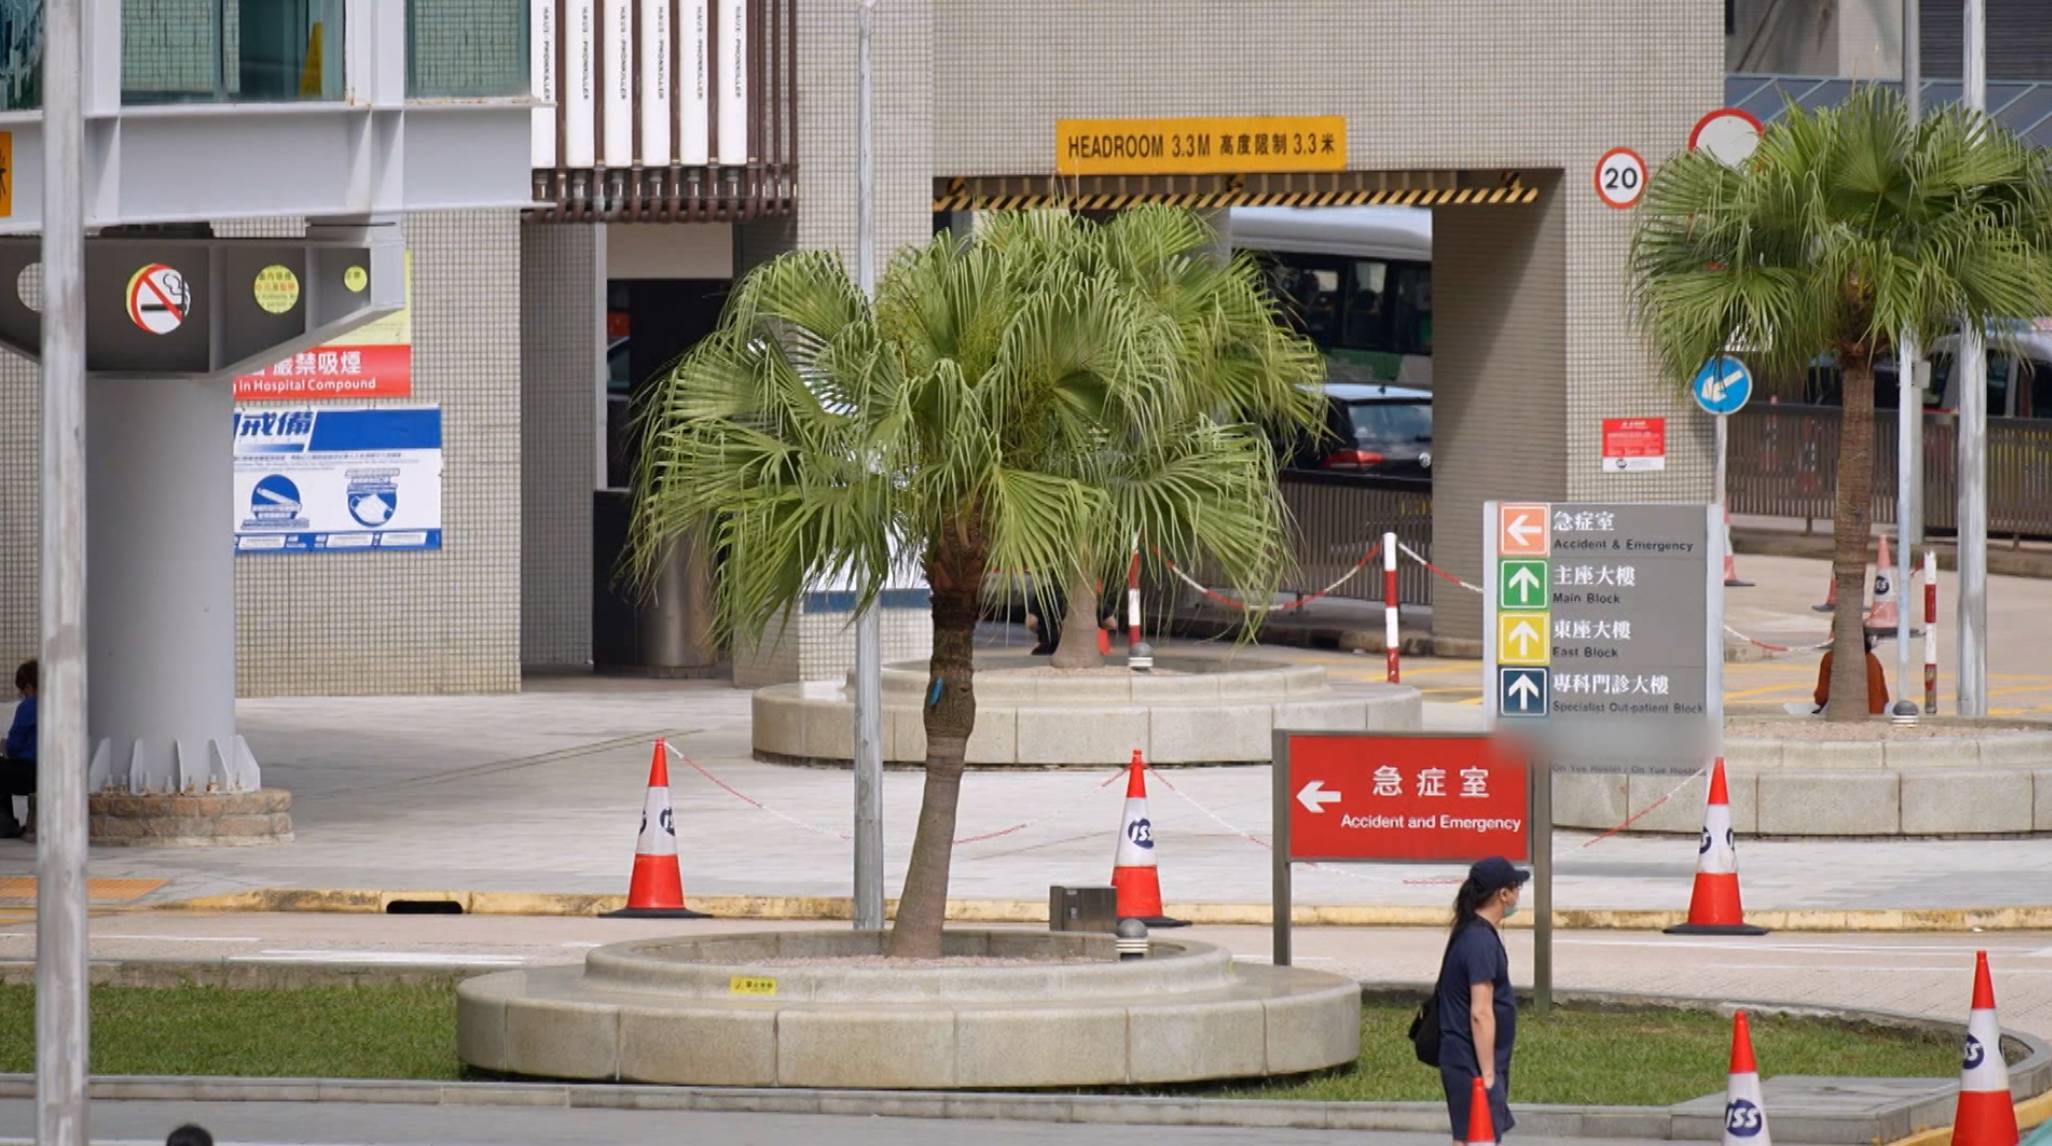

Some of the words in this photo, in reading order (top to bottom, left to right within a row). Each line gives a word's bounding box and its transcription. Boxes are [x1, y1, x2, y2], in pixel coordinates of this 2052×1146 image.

[1068, 135, 1164, 159] HEADROOM
[1172, 133, 1210, 158] 3.3M
[1219, 133, 1287, 155] 高度限制
[1605, 167, 1637, 190] 20
[239, 380, 250, 392] in
[253, 379, 305, 393] Hospital
[308, 378, 377, 392] Compound
[240, 411, 314, 436] 戒備
[1553, 510, 1615, 531] 急症室
[1554, 539, 1607, 549] Accident
[1611, 540, 1621, 549] &
[1626, 539, 1694, 552] Emergency
[1554, 564, 1636, 587] 主座大樓
[1552, 592, 1581, 603] Main
[1586, 592, 1621, 604] Block
[1554, 620, 1631, 640] 東座大樓
[1552, 646, 1579, 657] East
[1584, 646, 1618, 658] Block
[1553, 673, 1669, 695] 專科門診大樓
[1553, 701, 1605, 713] Specialist
[1609, 702, 1669, 714] Out-patient
[1673, 702, 1703, 714] Block
[1373, 765, 1489, 798] 急症室
[1341, 814, 1404, 829] Accident
[1408, 815, 1436, 829] and
[1440, 815, 1521, 832] Emergency
[1727, 1107, 1759, 1129] ISS
